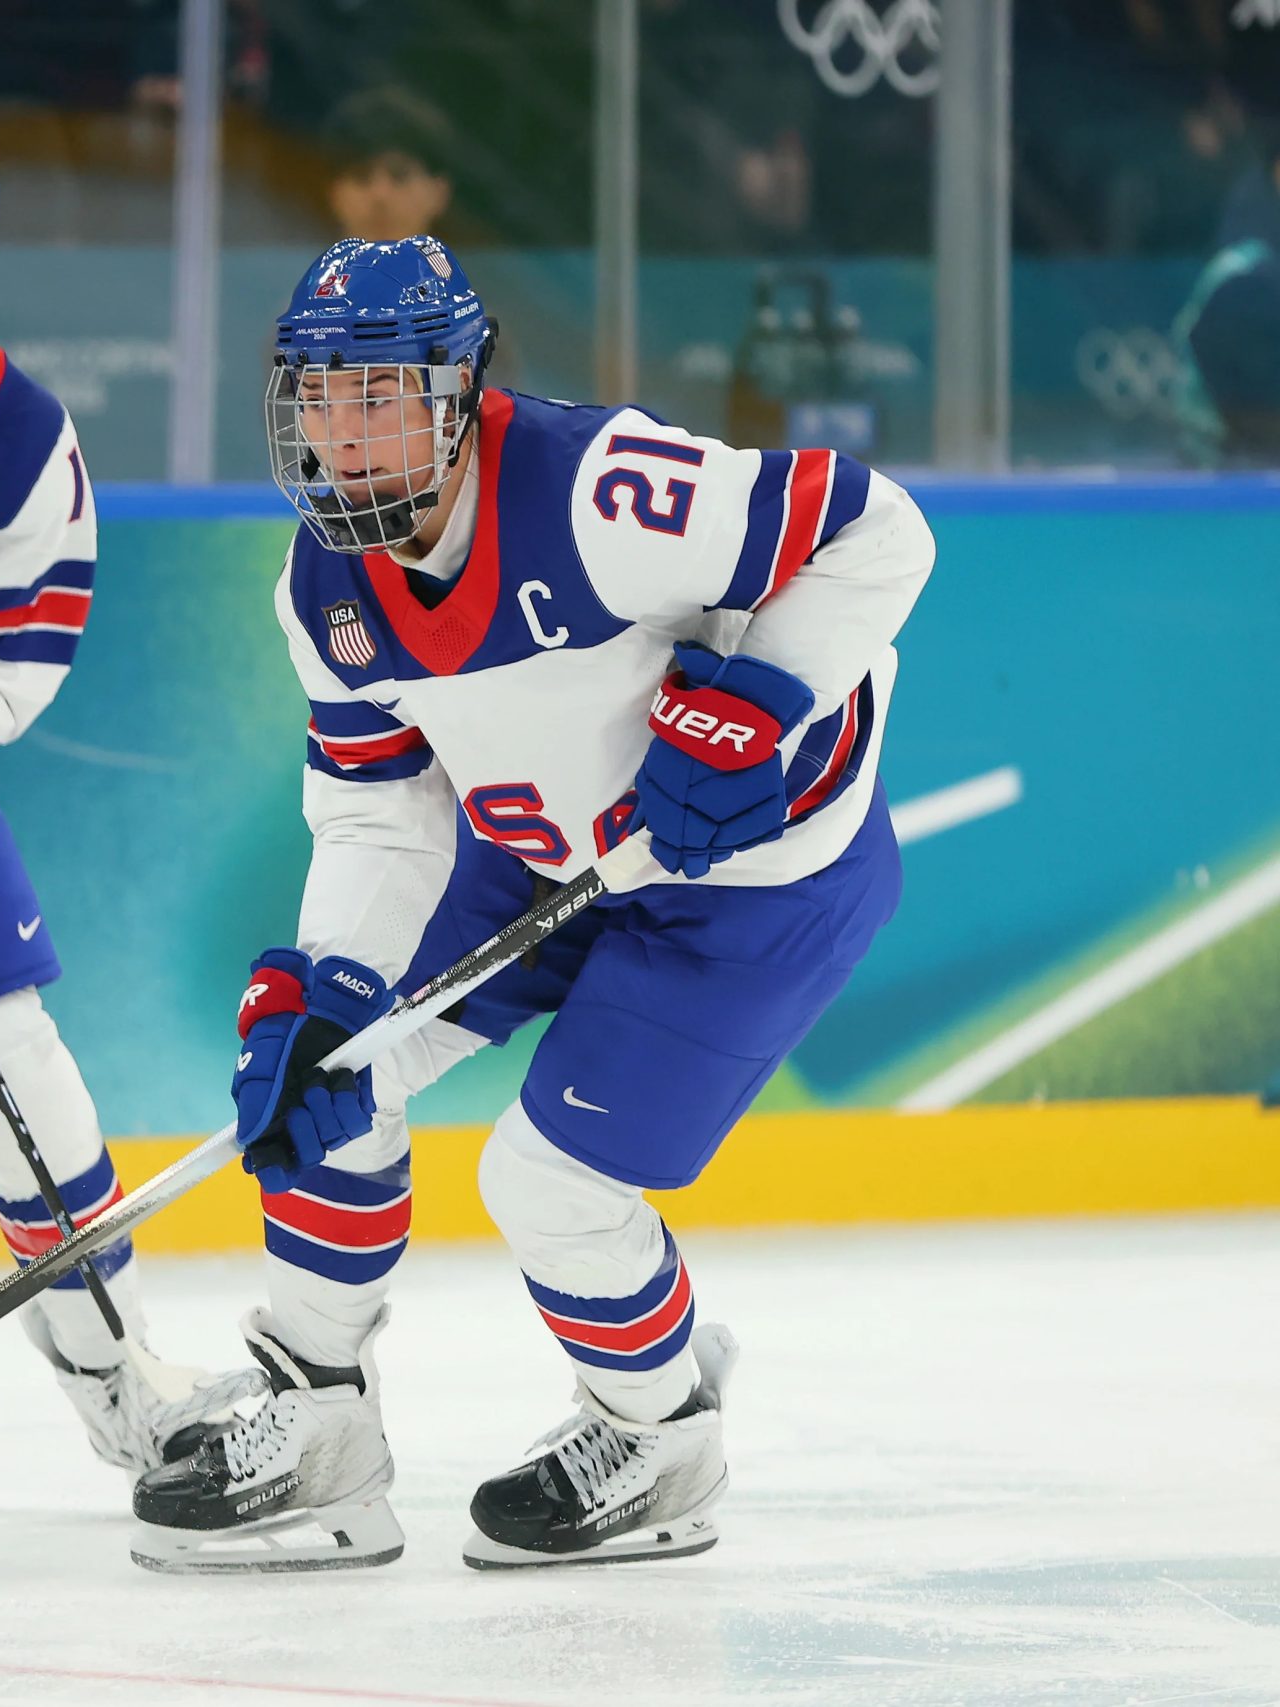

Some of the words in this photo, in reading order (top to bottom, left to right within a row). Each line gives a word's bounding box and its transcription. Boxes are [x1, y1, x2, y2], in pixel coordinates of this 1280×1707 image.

[454, 301, 480, 321] BAUER
[593, 434, 705, 537] 21
[329, 606, 357, 625] USA
[516, 579, 570, 650] C
[331, 970, 376, 999] MACH
[235, 1474, 301, 1515] BAUER
[595, 1491, 660, 1532] BAUER
